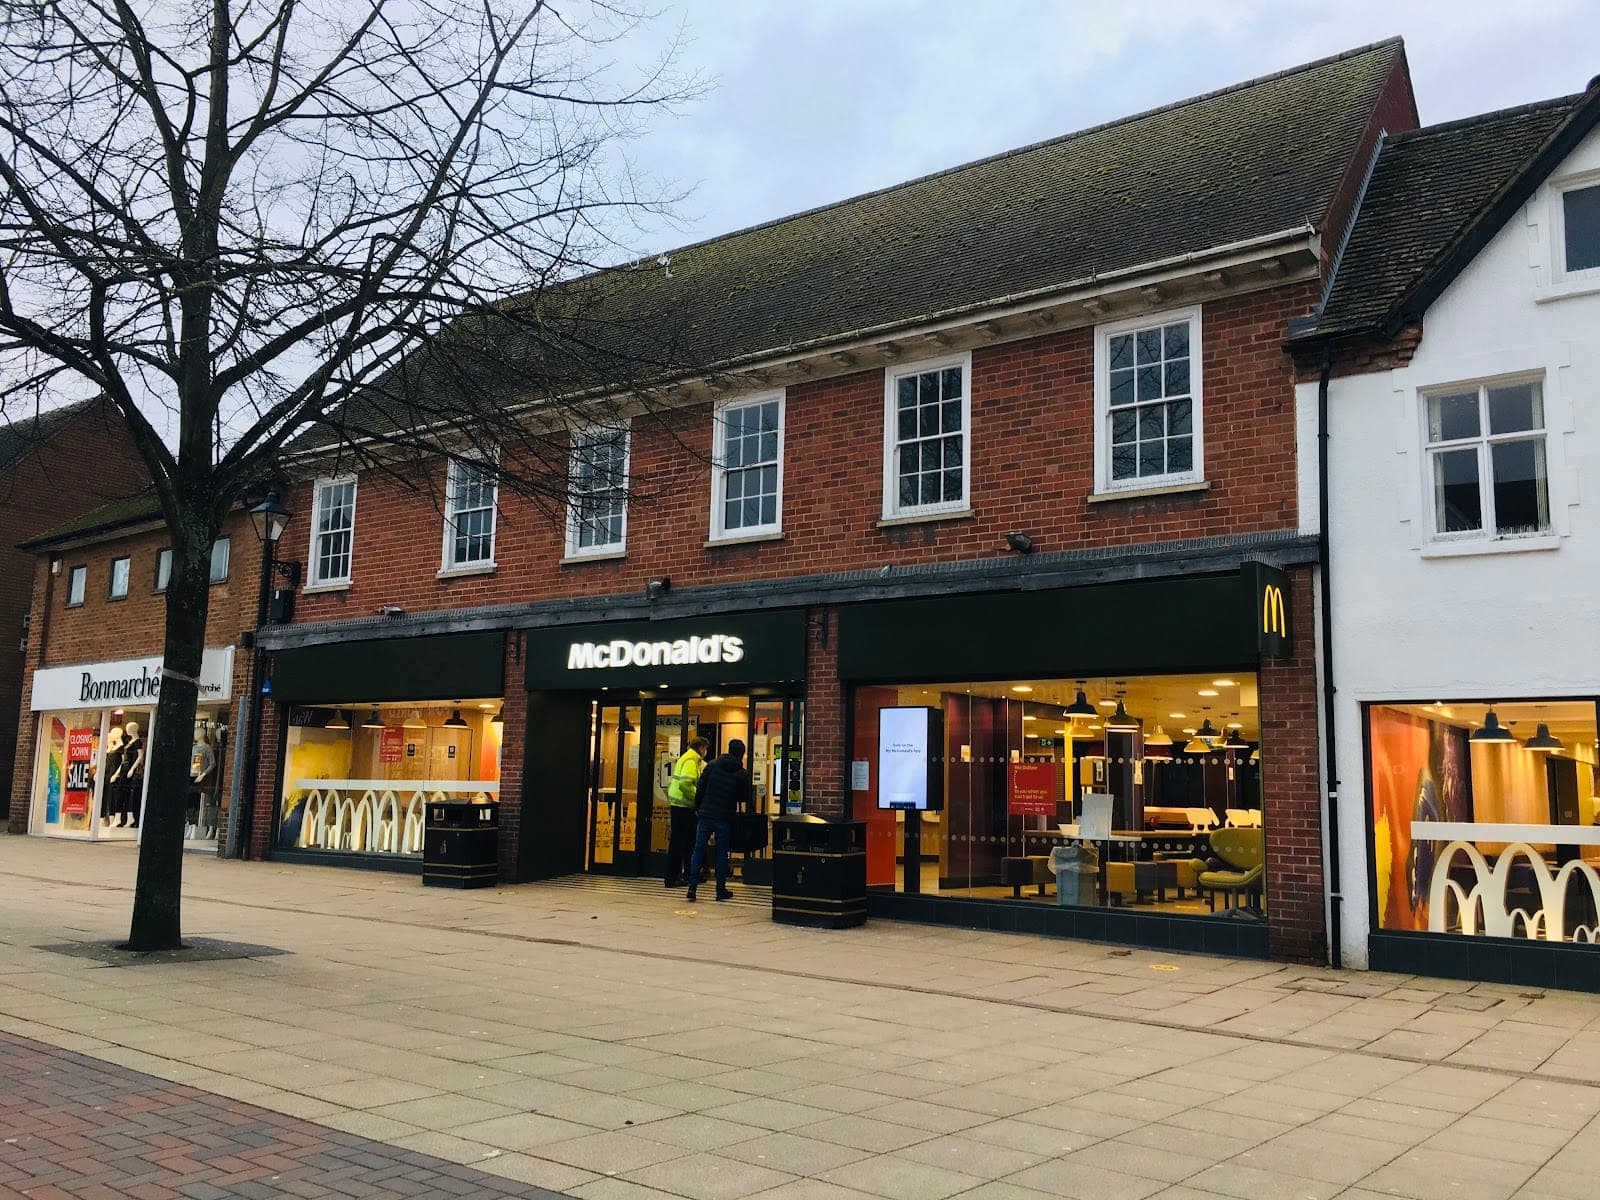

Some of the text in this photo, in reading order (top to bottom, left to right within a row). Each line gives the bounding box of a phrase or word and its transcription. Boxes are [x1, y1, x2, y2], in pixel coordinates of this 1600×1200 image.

[567, 634, 744, 669] McDonald's
[79, 666, 160, 701] Bonmarché
[70, 734, 93, 745] CLOSING
[71, 746, 89, 757] DOWN
[67, 763, 89, 788] SALE
